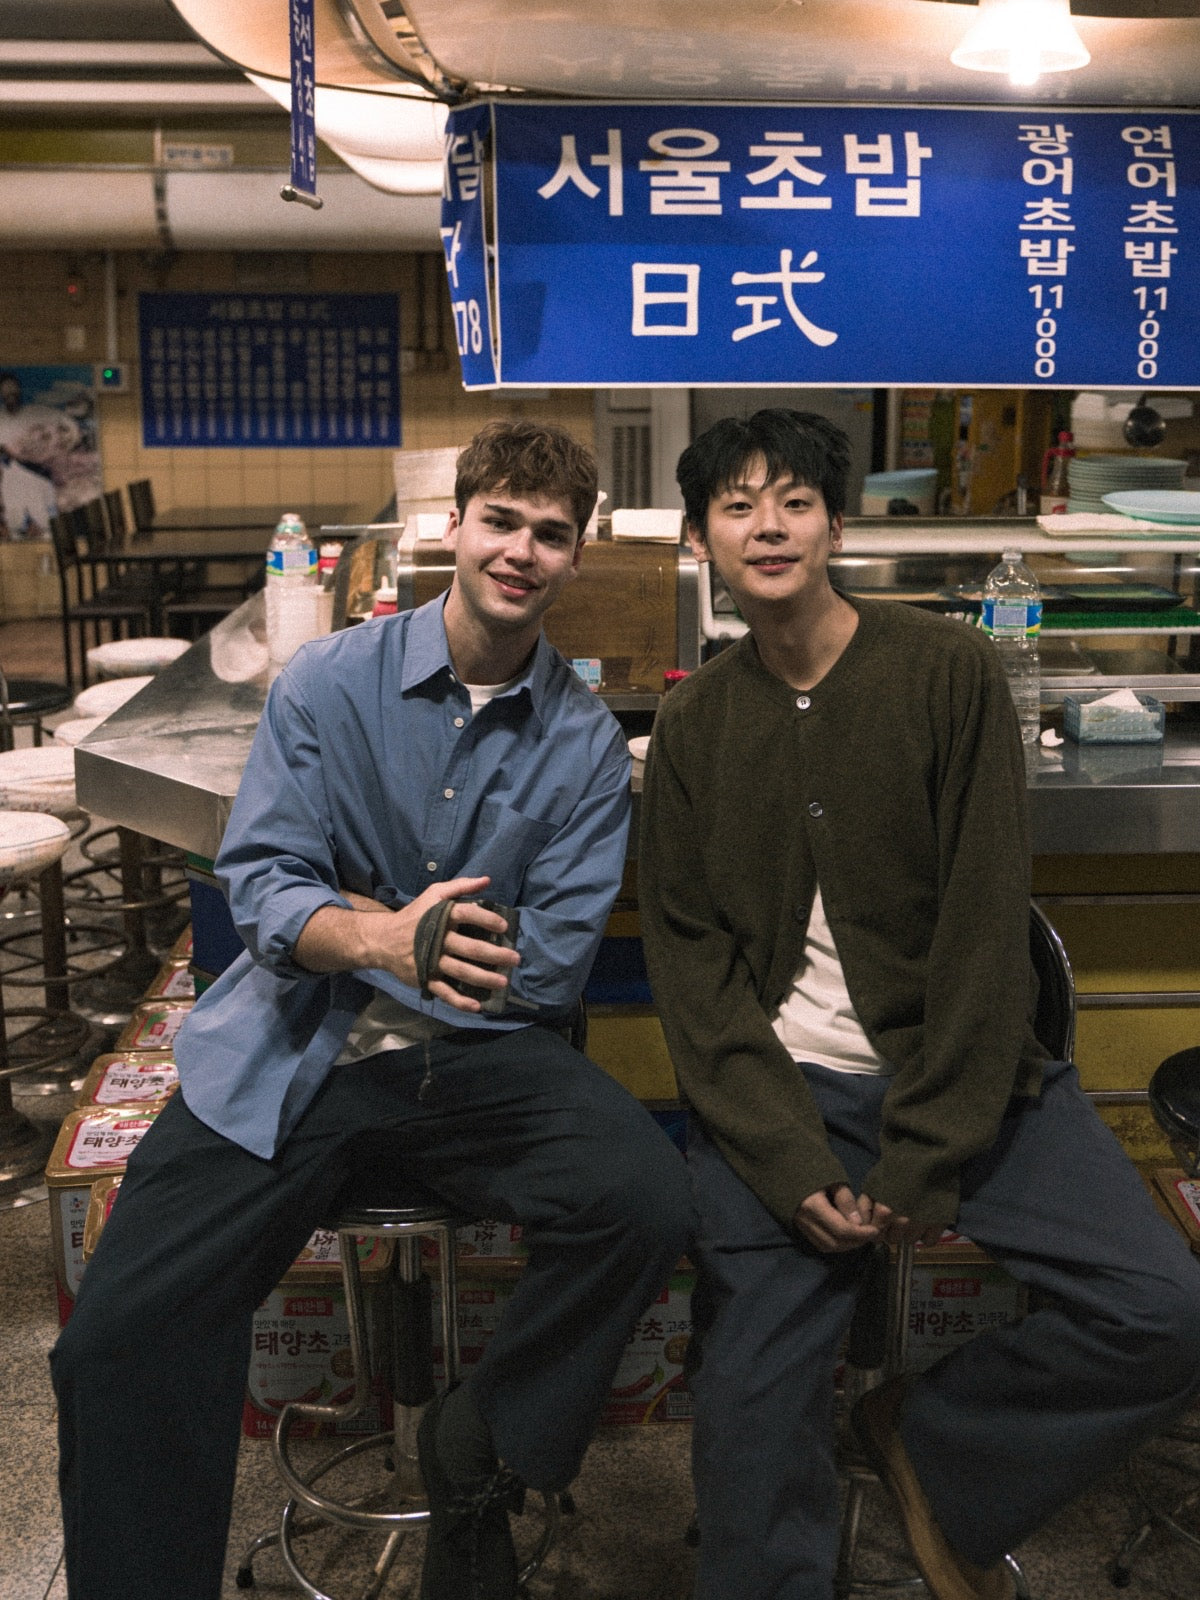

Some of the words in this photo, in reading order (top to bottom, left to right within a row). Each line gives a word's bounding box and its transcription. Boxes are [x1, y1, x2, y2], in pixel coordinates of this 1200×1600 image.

[537, 127, 933, 217] 서울초밥
[1018, 124, 1076, 277] 광어초밥
[1121, 124, 1179, 278] 연어초밥
[631, 248, 839, 347] 日式
[1028, 285, 1064, 379] 11,000
[1133, 285, 1169, 380] 11,000
[254, 1329, 331, 1356] 태양초
